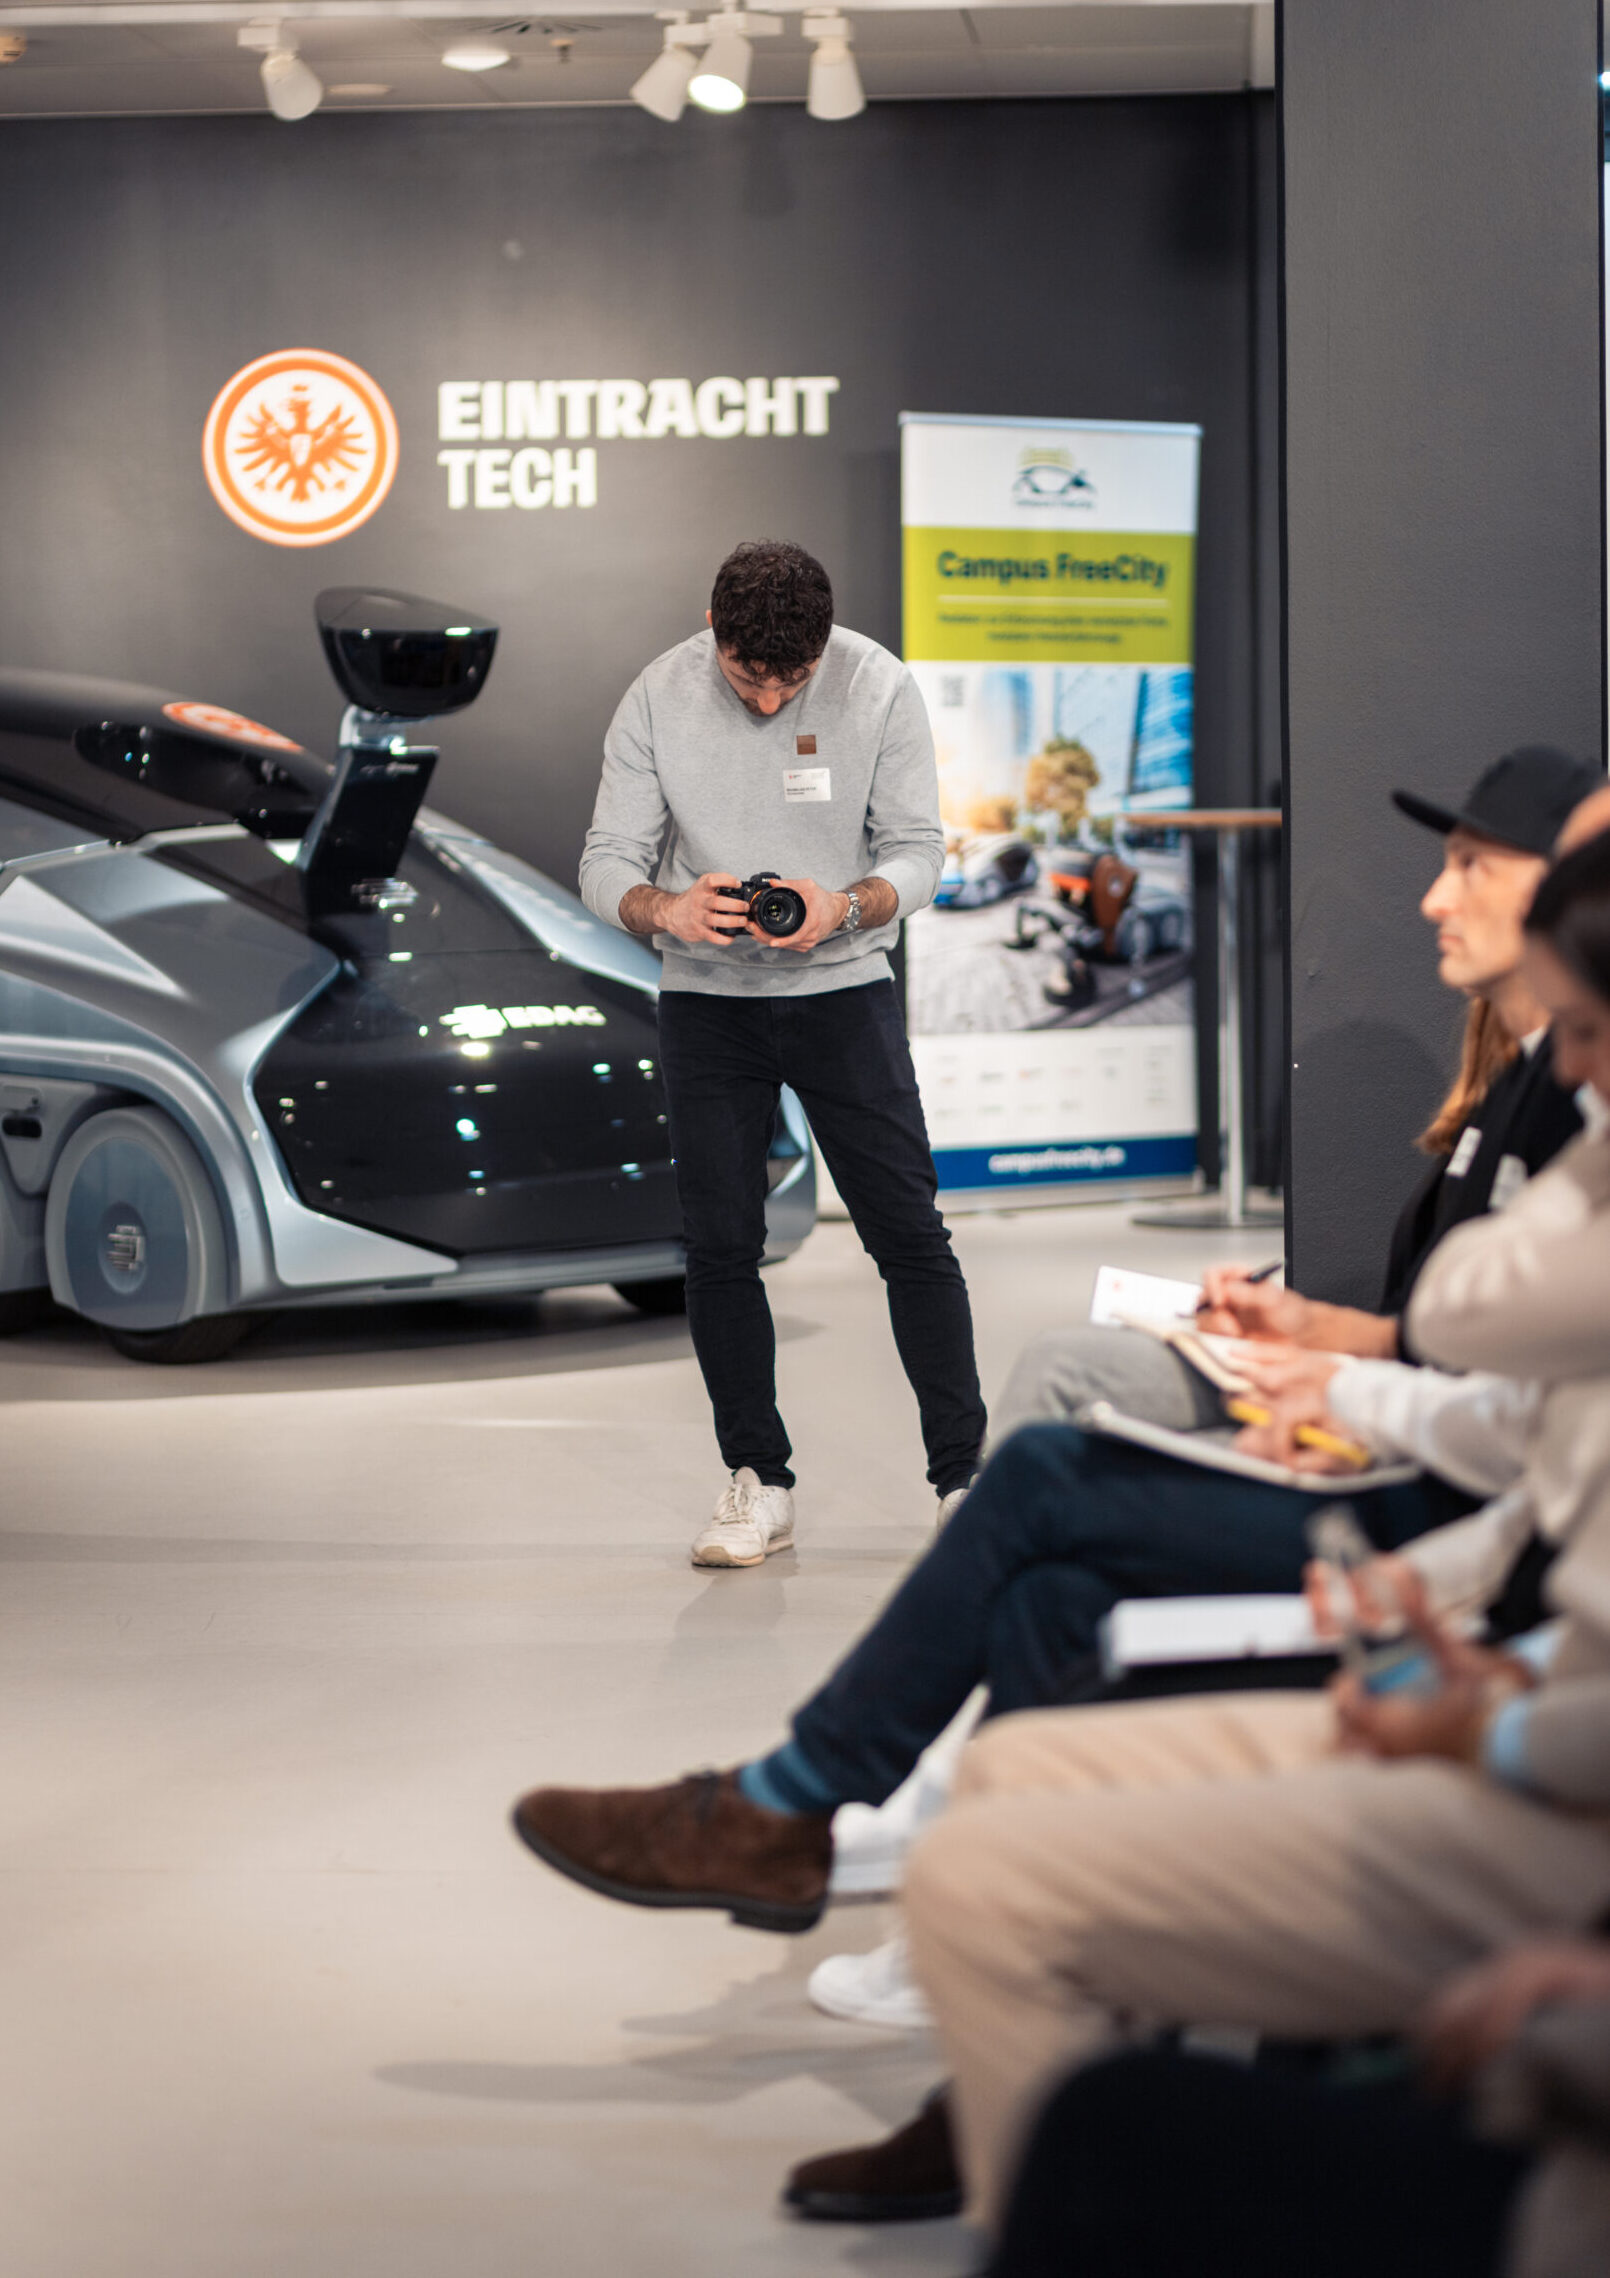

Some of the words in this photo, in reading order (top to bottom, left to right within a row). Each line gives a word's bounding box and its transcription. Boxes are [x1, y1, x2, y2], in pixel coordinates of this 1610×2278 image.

[438, 376, 840, 440] EINTRACHT
[438, 447, 598, 511] TECH
[938, 550, 1049, 585] Campus
[1057, 553, 1166, 588] FreeCity
